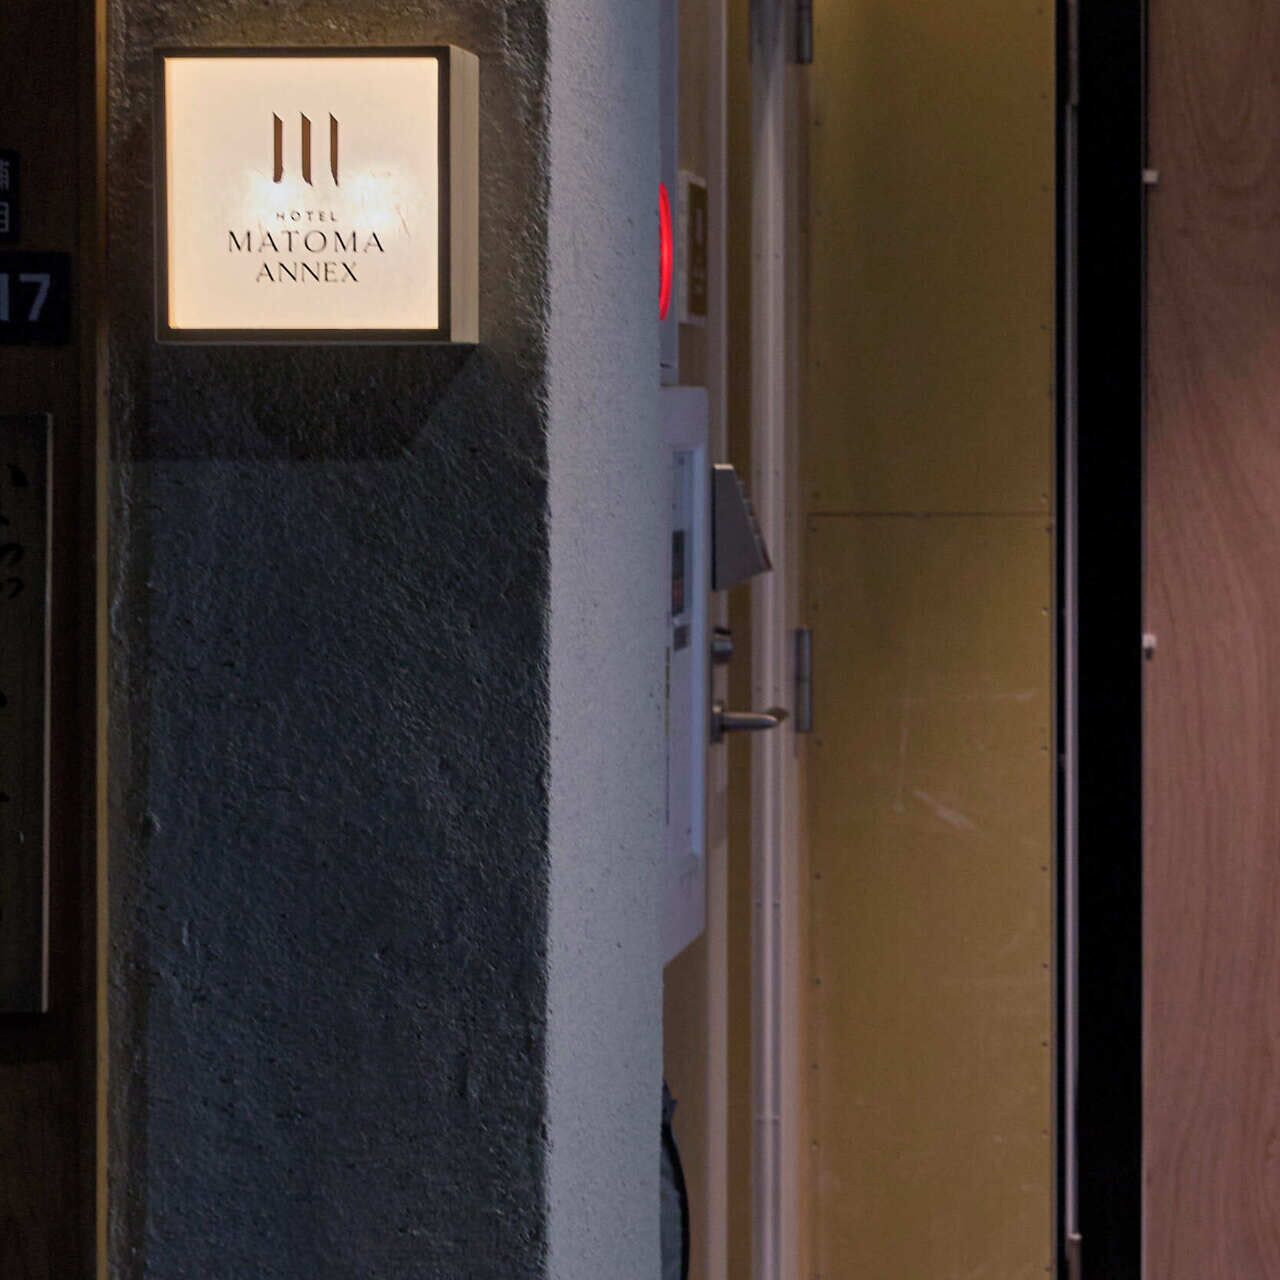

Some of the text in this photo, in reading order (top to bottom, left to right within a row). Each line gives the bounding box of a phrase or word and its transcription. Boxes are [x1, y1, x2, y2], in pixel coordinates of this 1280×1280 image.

[276, 211, 338, 222] HOTEL
[228, 230, 384, 253] MATOMA
[256, 261, 359, 282] ANNEX
